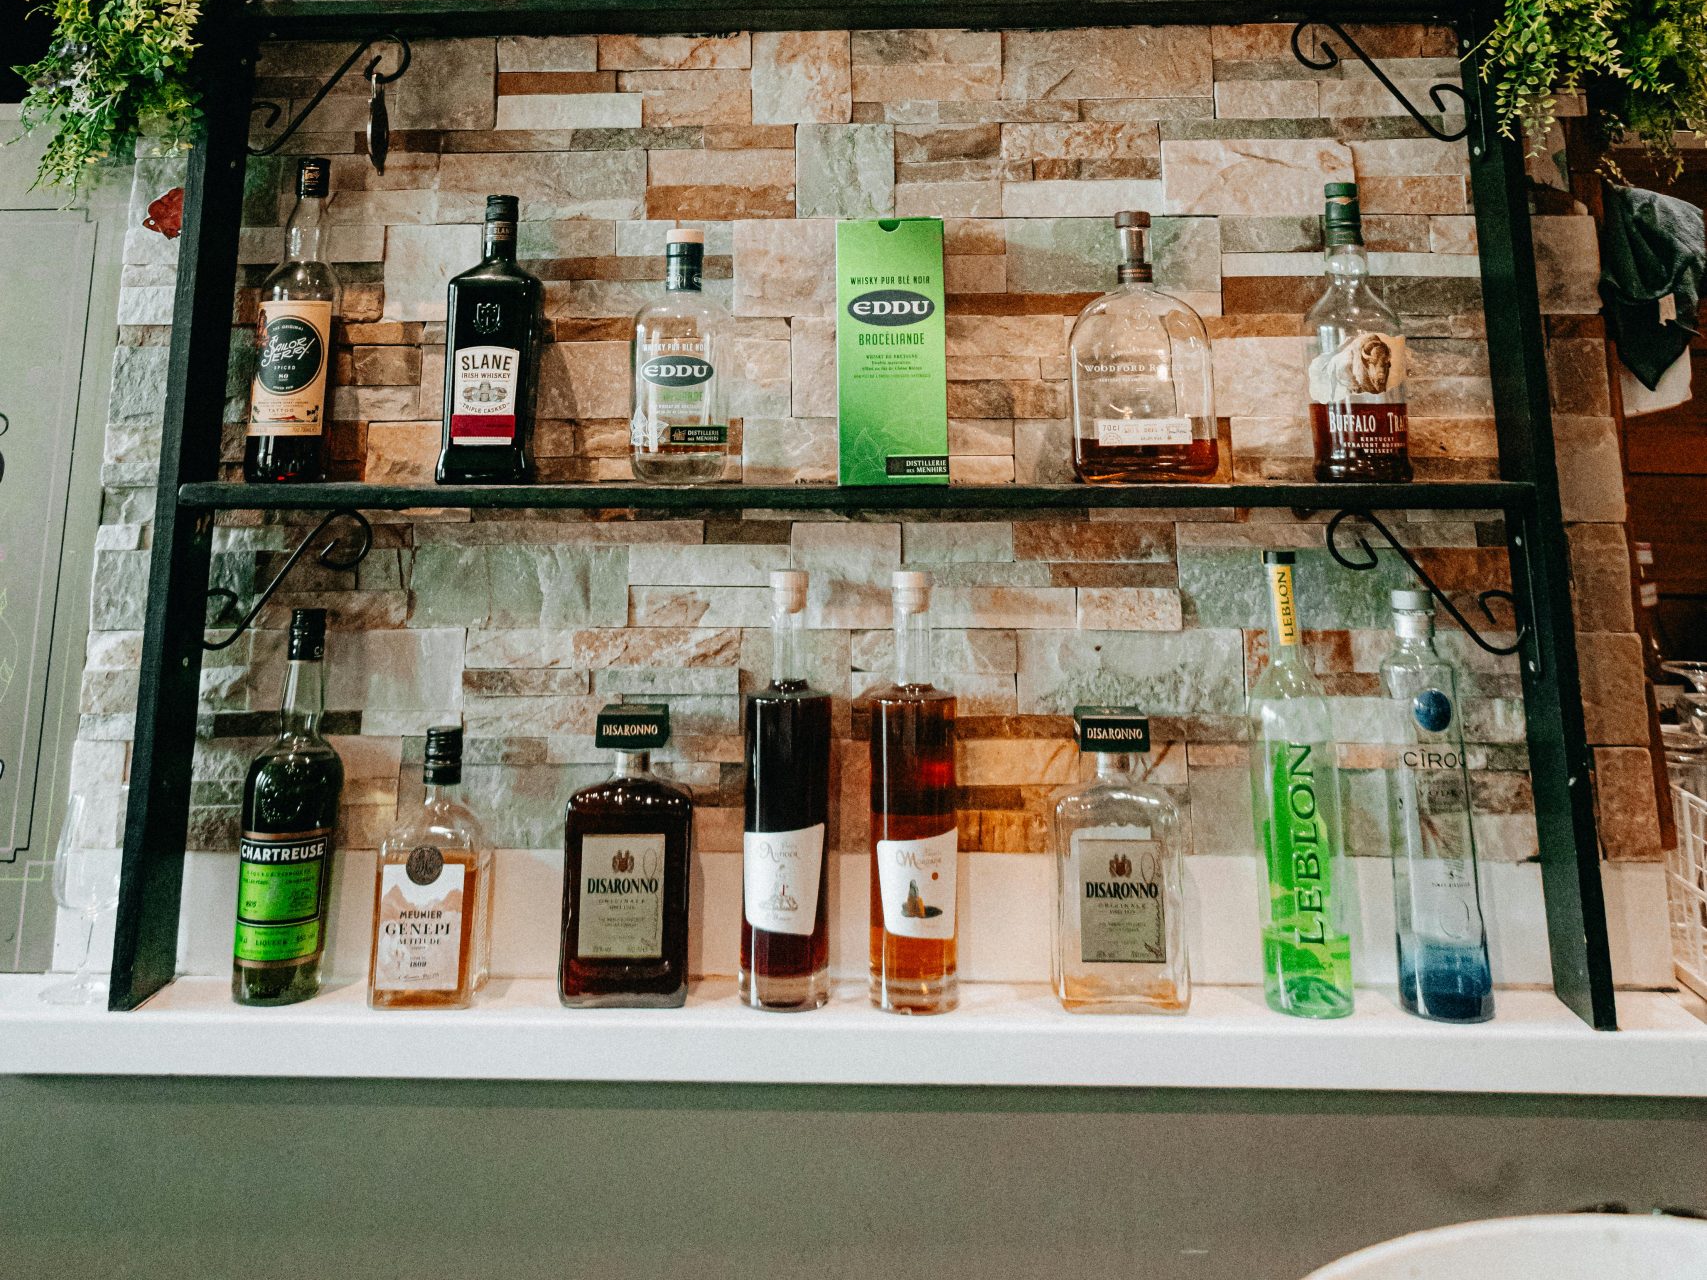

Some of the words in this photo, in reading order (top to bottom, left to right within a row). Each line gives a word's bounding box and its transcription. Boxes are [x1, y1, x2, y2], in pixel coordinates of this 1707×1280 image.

[850, 276, 878, 286] WHISKY
[881, 276, 895, 285] PUR
[898, 274, 910, 285] BLÉ
[913, 276, 930, 284] NOIR
[461, 354, 513, 371] SLANE
[1084, 363, 1145, 373] WOODFORD
[462, 403, 482, 414] TRIPLE
[483, 403, 507, 414] CASKED
[1328, 410, 1376, 433] BUFFALO
[906, 459, 947, 467] DISTILLERIE
[1277, 571, 1294, 637] LEBLON
[602, 724, 658, 736] DISARONNO
[1087, 727, 1143, 740] DISARONNO
[241, 842, 325, 862] CHARTREUSE
[1289, 743, 1325, 946] LEBLON
[587, 878, 659, 895] DISARONNO
[1085, 881, 1159, 900] DISARONNO
[400, 910, 443, 919] MEUNIER
